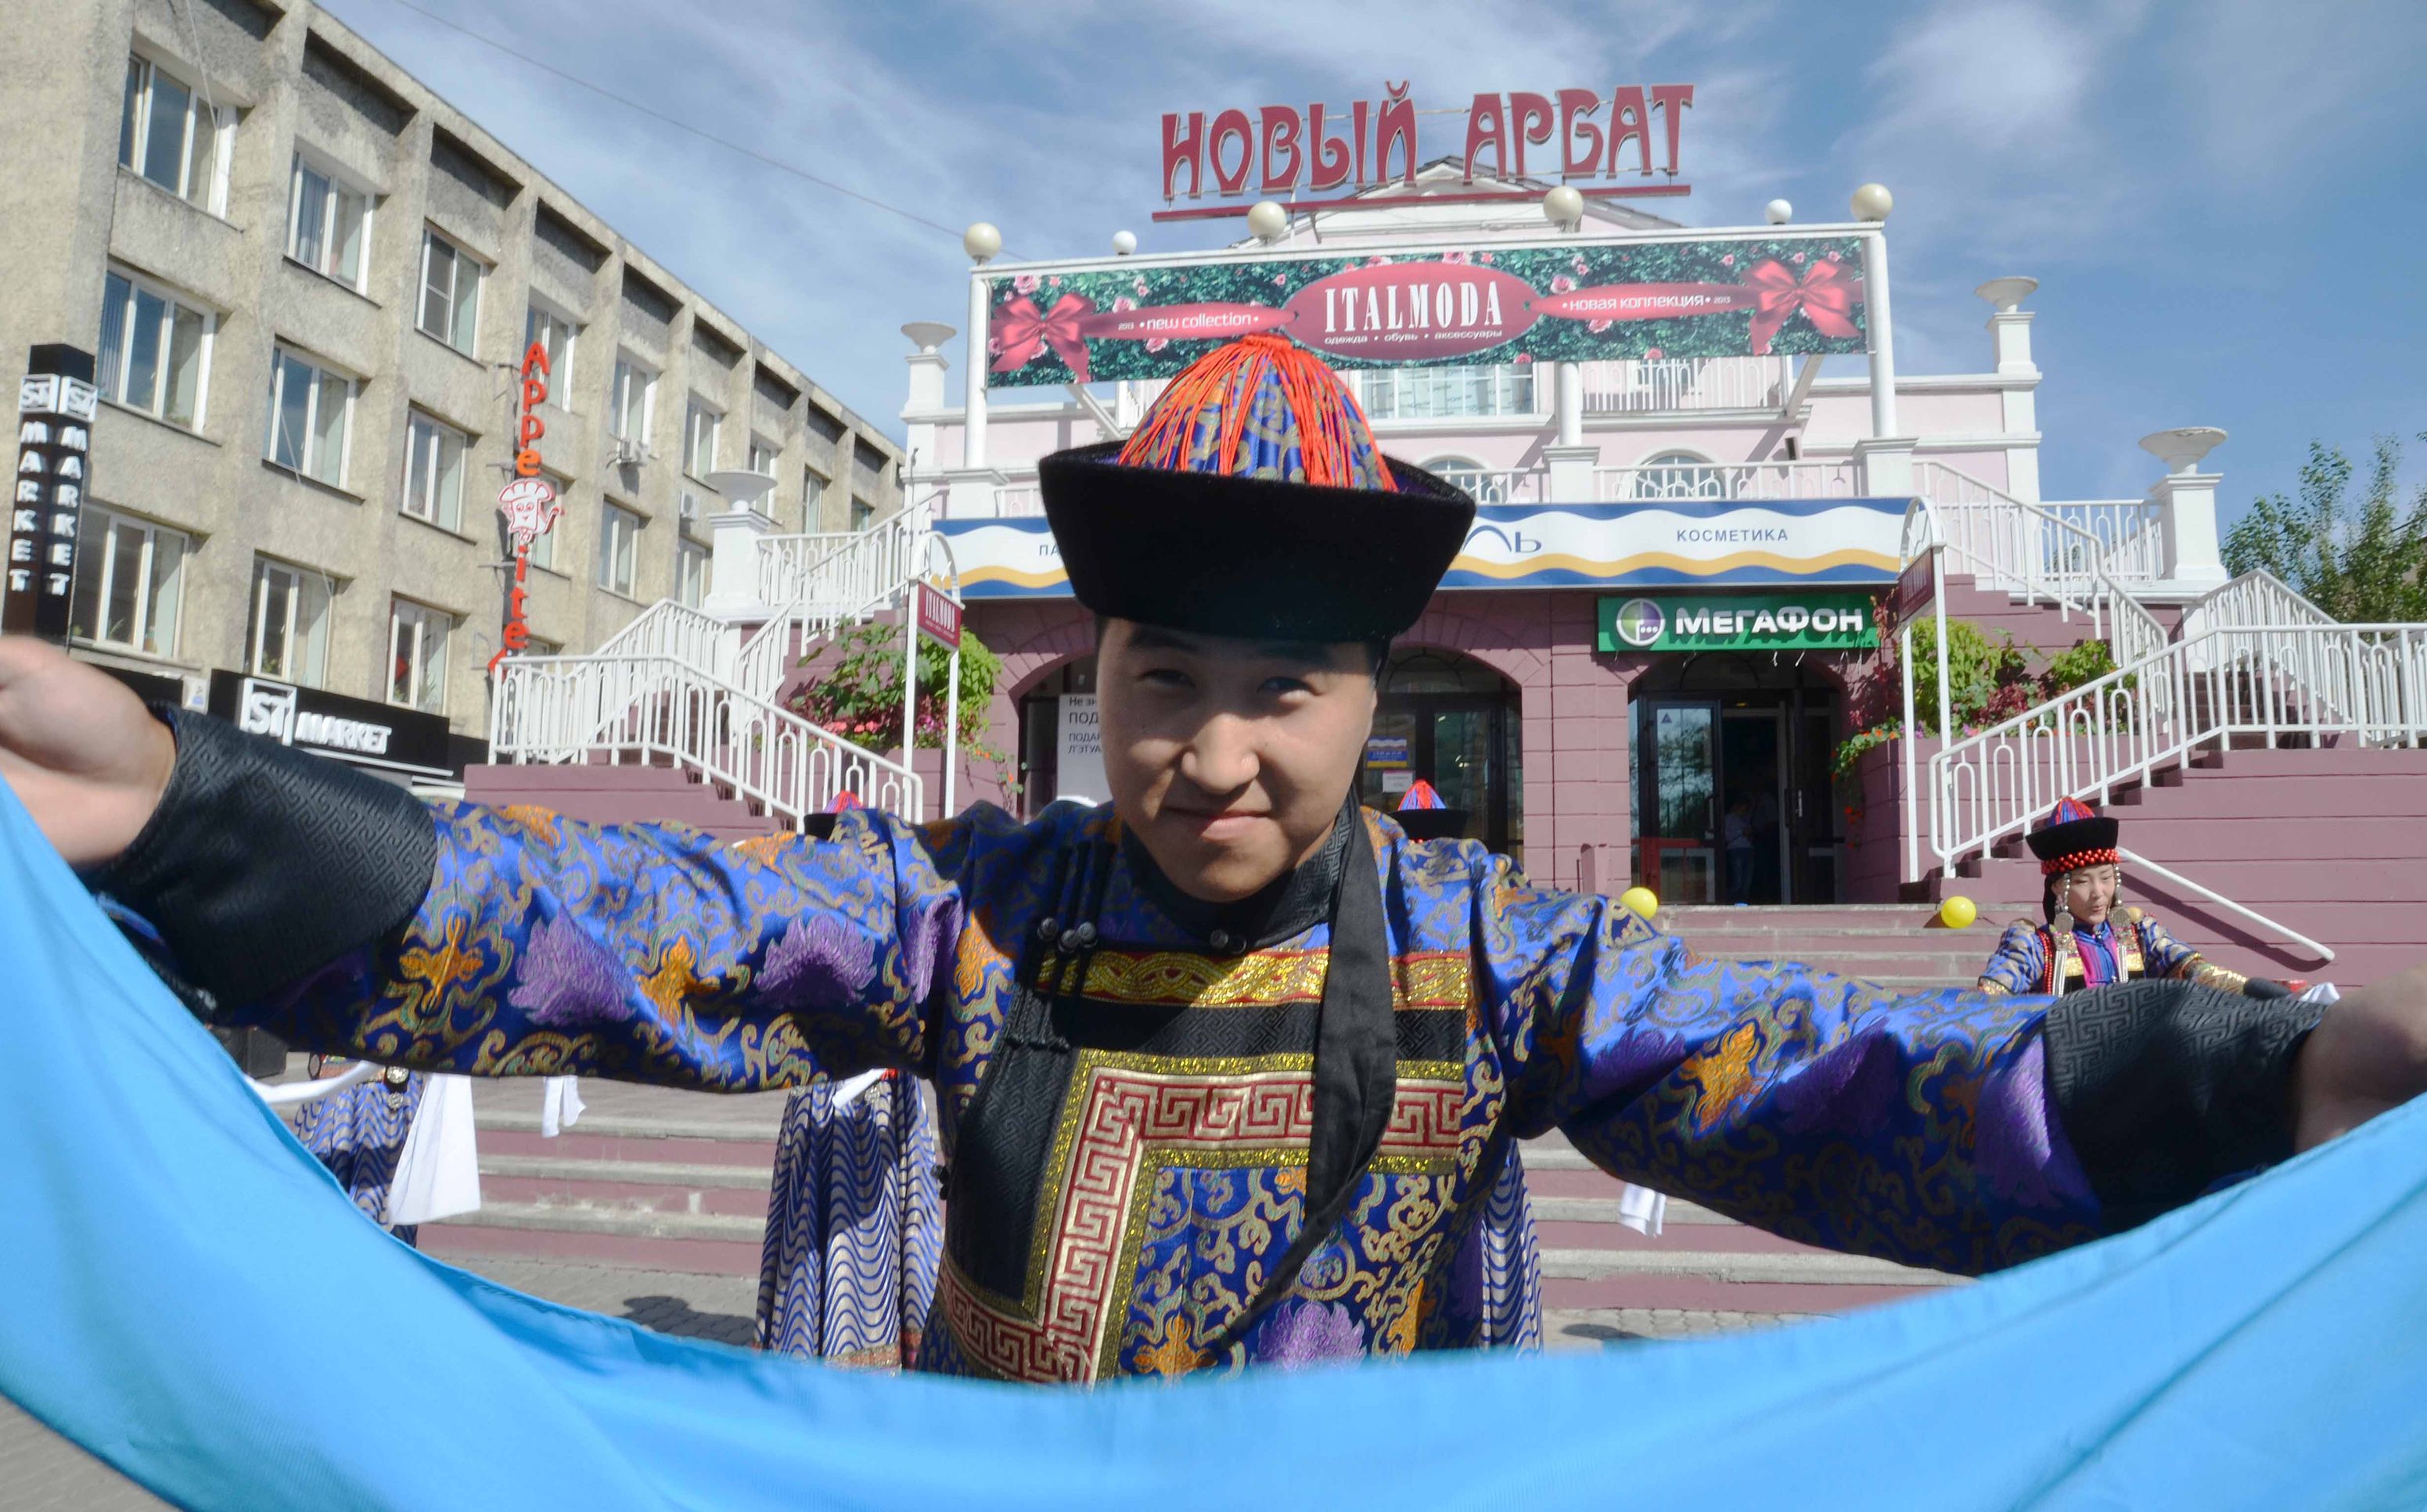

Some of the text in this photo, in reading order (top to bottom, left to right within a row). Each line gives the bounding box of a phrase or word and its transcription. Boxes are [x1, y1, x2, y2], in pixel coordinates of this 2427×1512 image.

[1162, 80, 1695, 200] НОВЫЙ АРБАТ
[1146, 318, 1179, 330] new
[1181, 312, 1252, 329] collection
[1325, 281, 1503, 332] ITALMODA
[1324, 330, 1503, 345] одежда обувь аксессуары
[9, 421, 49, 592] MARKET
[49, 426, 88, 596] MARKET
[1677, 528, 1789, 542] КОСМЕТИКА
[1069, 696, 1084, 707] Не
[294, 711, 393, 755] MARKET
